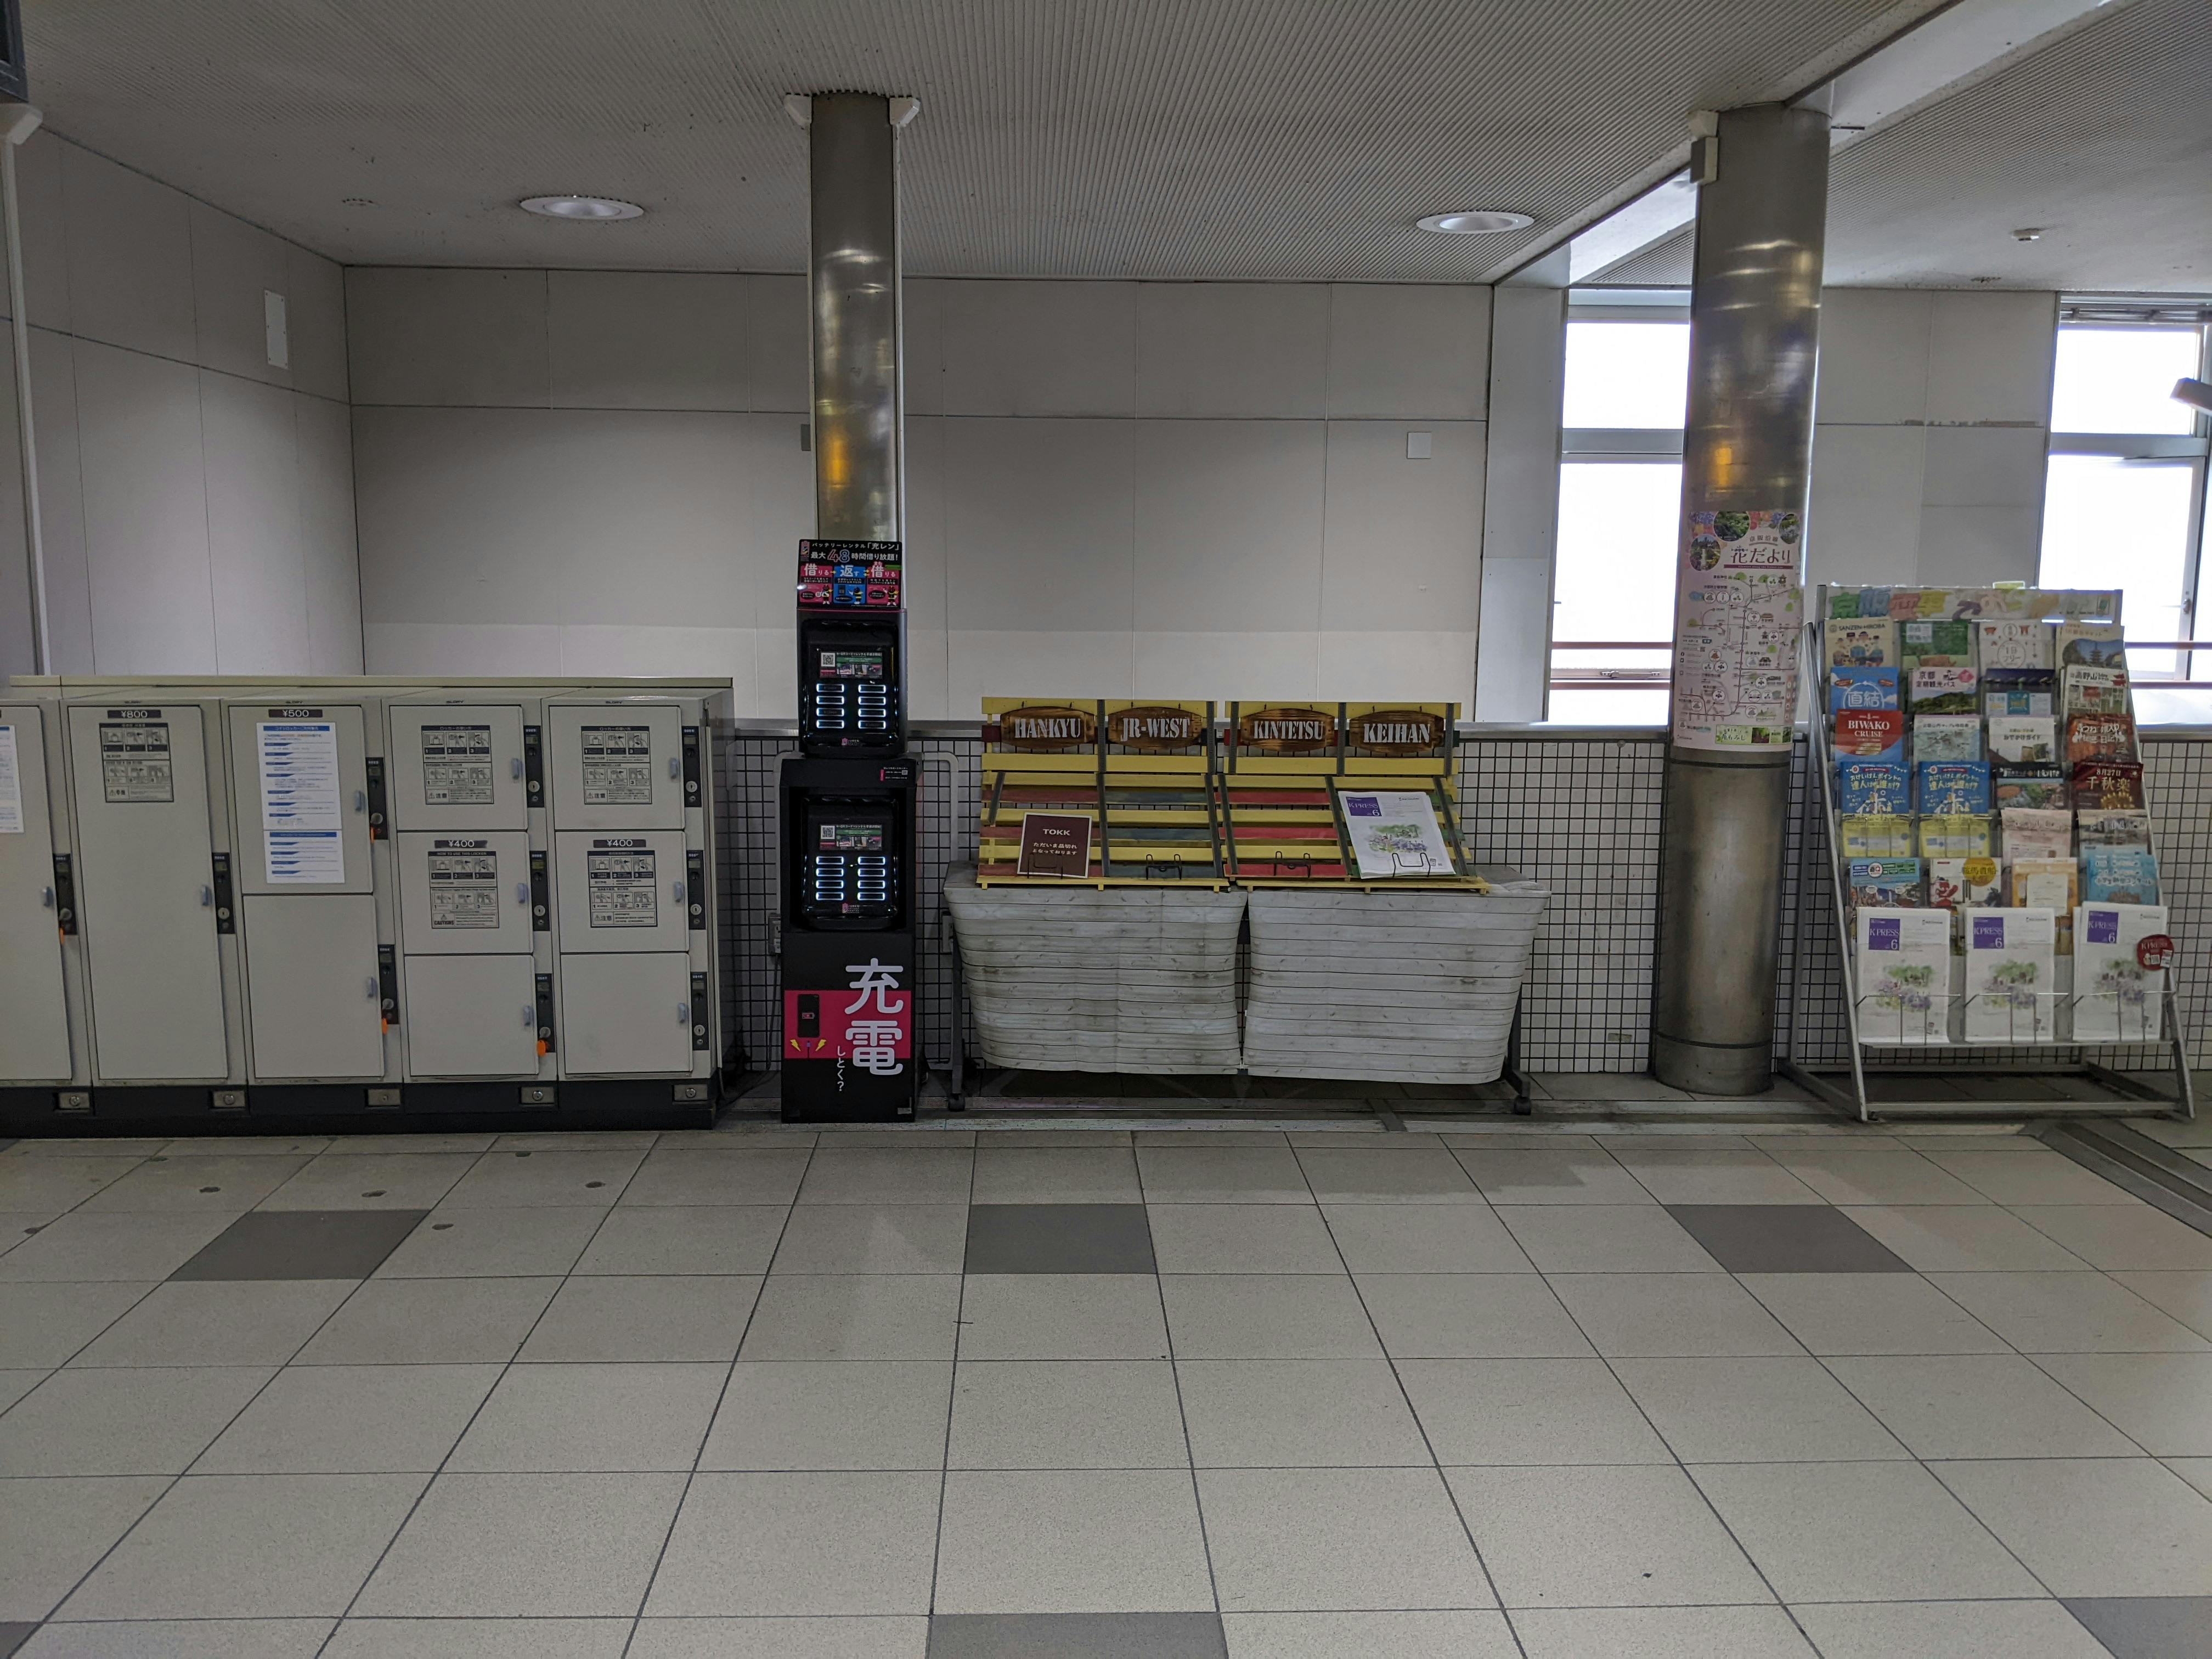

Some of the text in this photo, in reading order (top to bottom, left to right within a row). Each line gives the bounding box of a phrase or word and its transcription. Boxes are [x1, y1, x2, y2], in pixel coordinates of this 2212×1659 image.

[1730, 545, 1791, 564] 花だより
[804, 563, 830, 577] 借りる
[840, 564, 860, 578] 返す
[871, 565, 896, 578] 借りる
[1918, 671, 1936, 680] 京都
[1848, 690, 1881, 707] 直結
[283, 709, 309, 718] ¥500
[1014, 718, 1081, 738] HANKYU
[1120, 718, 1191, 742] JR-WEST
[1254, 720, 1324, 740] KINTETSU
[1848, 720, 1890, 730] BIWAKO
[1363, 723, 1431, 743] KEIHAN
[2085, 776, 2130, 792] 千秋楽
[2095, 922, 2117, 930] PRESS
[1891, 939, 1898, 950] 6
[1995, 938, 2002, 949] 6
[2108, 932, 2115, 944] 6
[844, 957, 904, 1076] 充電
[836, 1045, 845, 1092] しとく?
